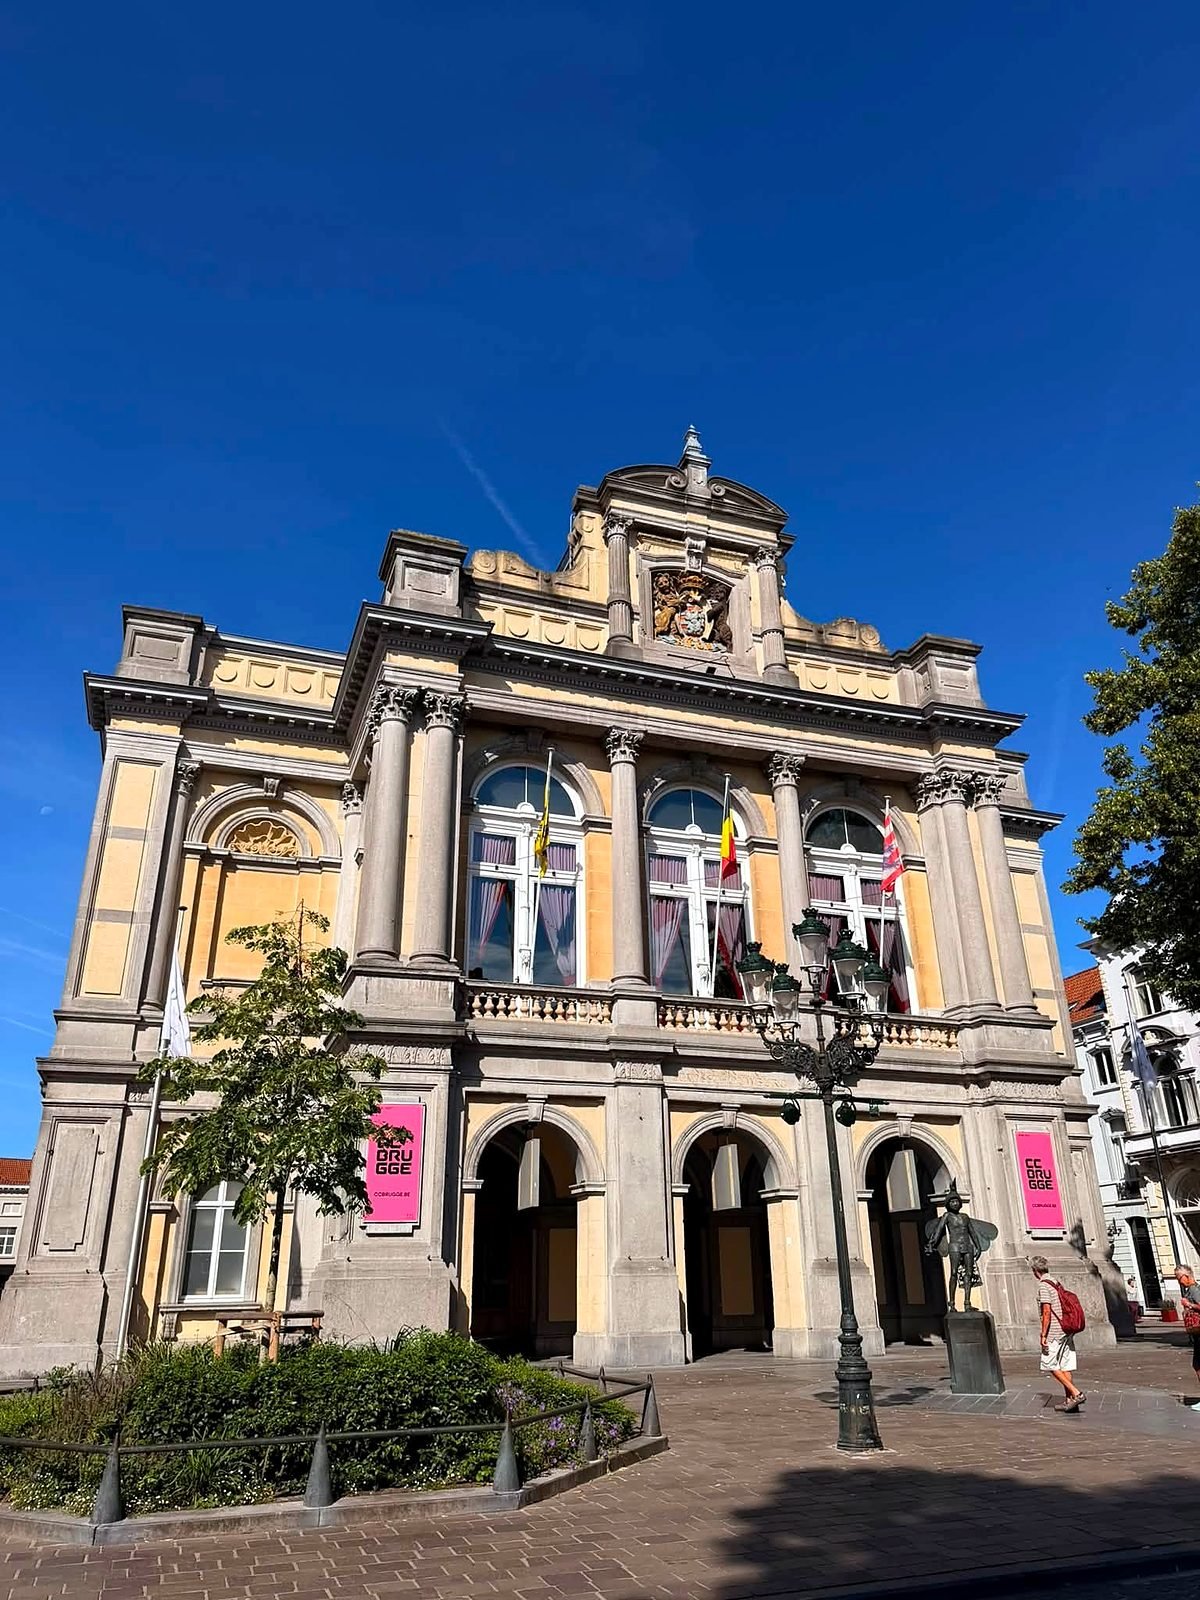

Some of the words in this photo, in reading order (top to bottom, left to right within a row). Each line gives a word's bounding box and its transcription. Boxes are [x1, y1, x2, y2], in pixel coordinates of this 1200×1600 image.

[377, 1150, 412, 1161] BRU
[376, 1162, 412, 1174] GGE
[1025, 1158, 1042, 1168] CC
[1027, 1169, 1051, 1179] BRU
[1029, 1180, 1053, 1190] GGE
